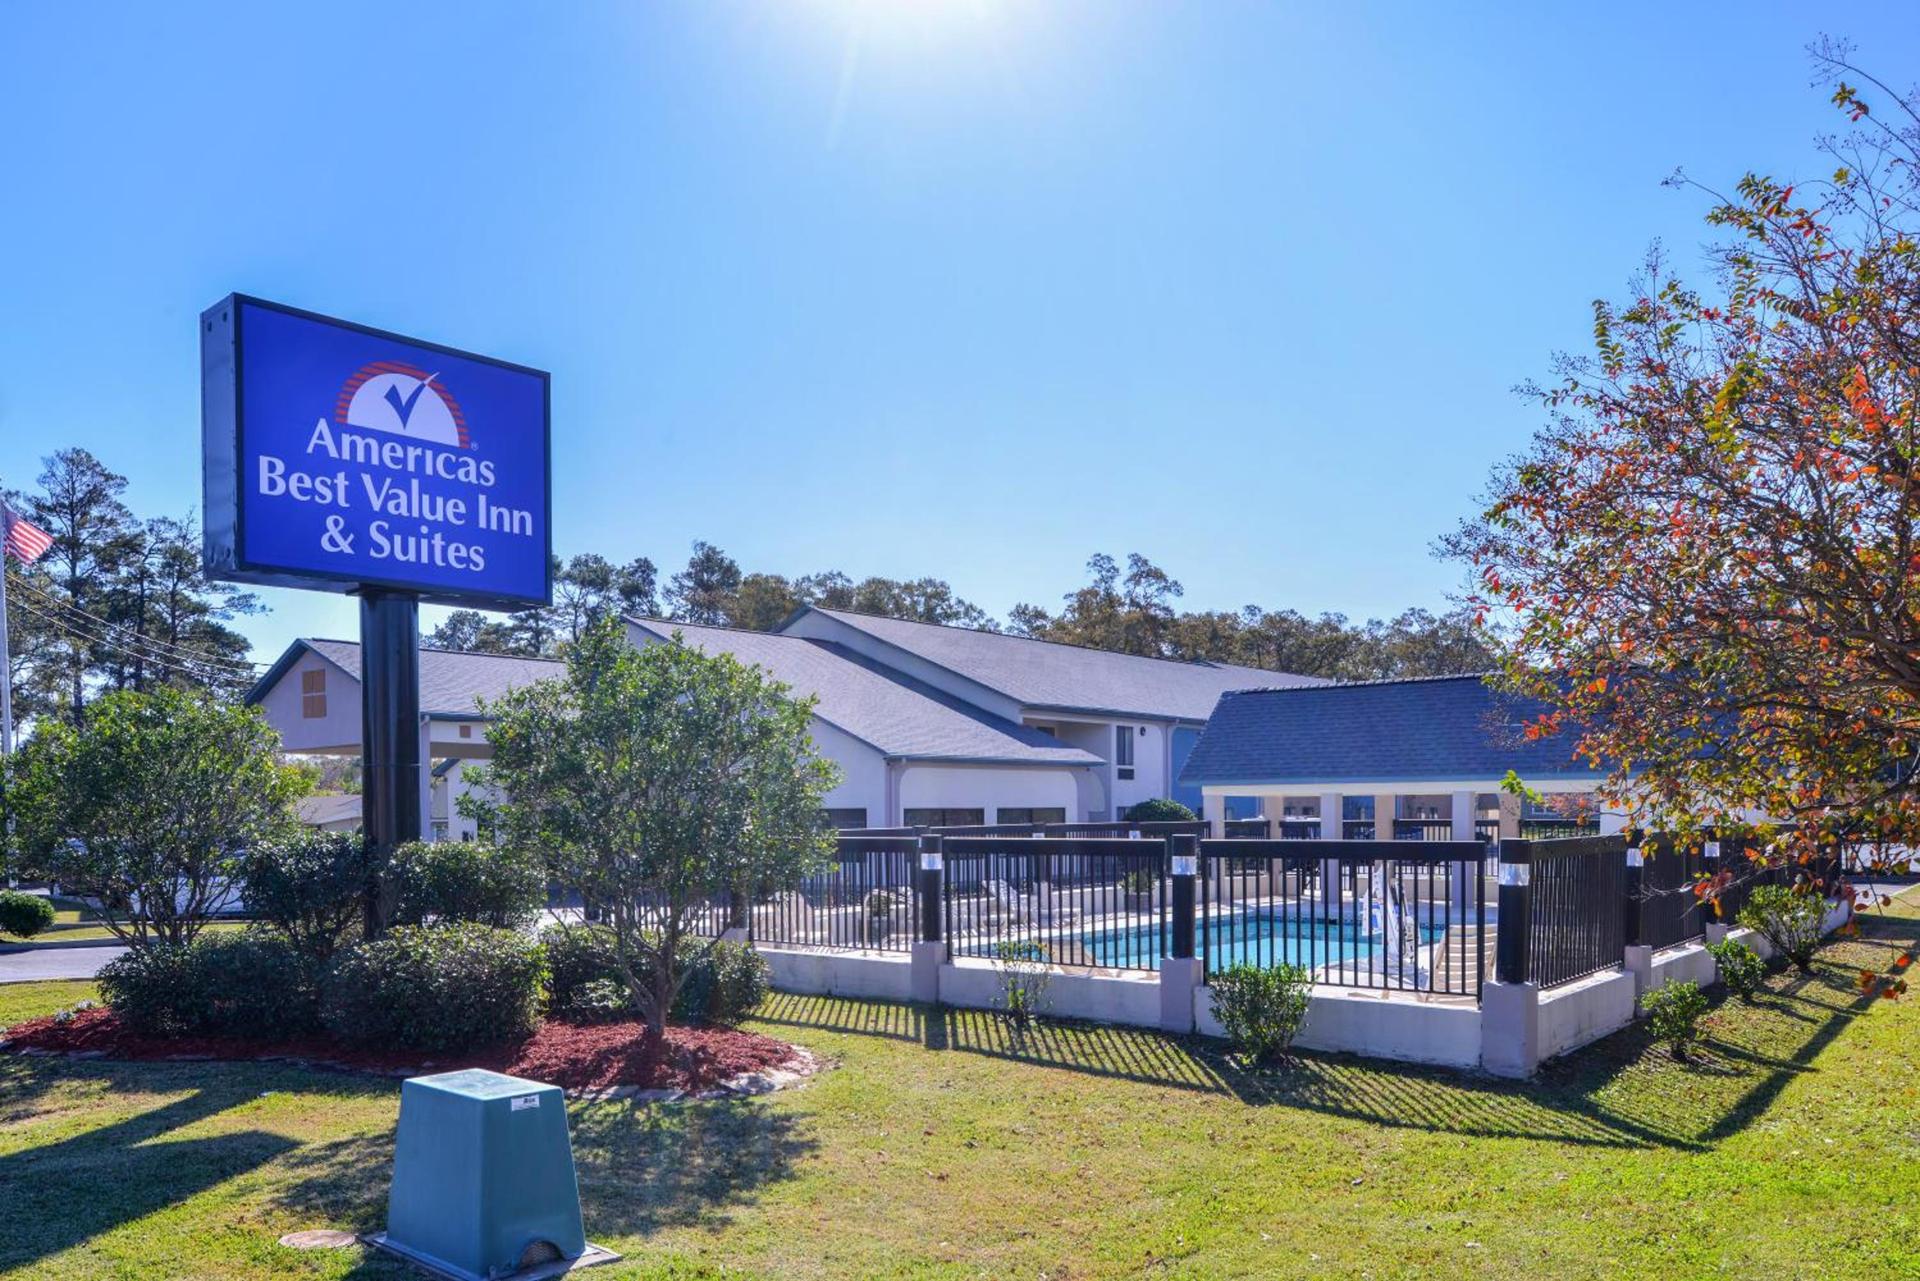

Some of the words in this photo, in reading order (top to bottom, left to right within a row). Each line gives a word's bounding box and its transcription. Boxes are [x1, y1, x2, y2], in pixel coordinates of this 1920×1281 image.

[306, 417, 496, 487] Americas
[259, 455, 350, 508] Best
[361, 472, 467, 526] Value
[478, 493, 533, 537] Inn
[320, 514, 355, 555] &
[369, 520, 486, 572] Suites
